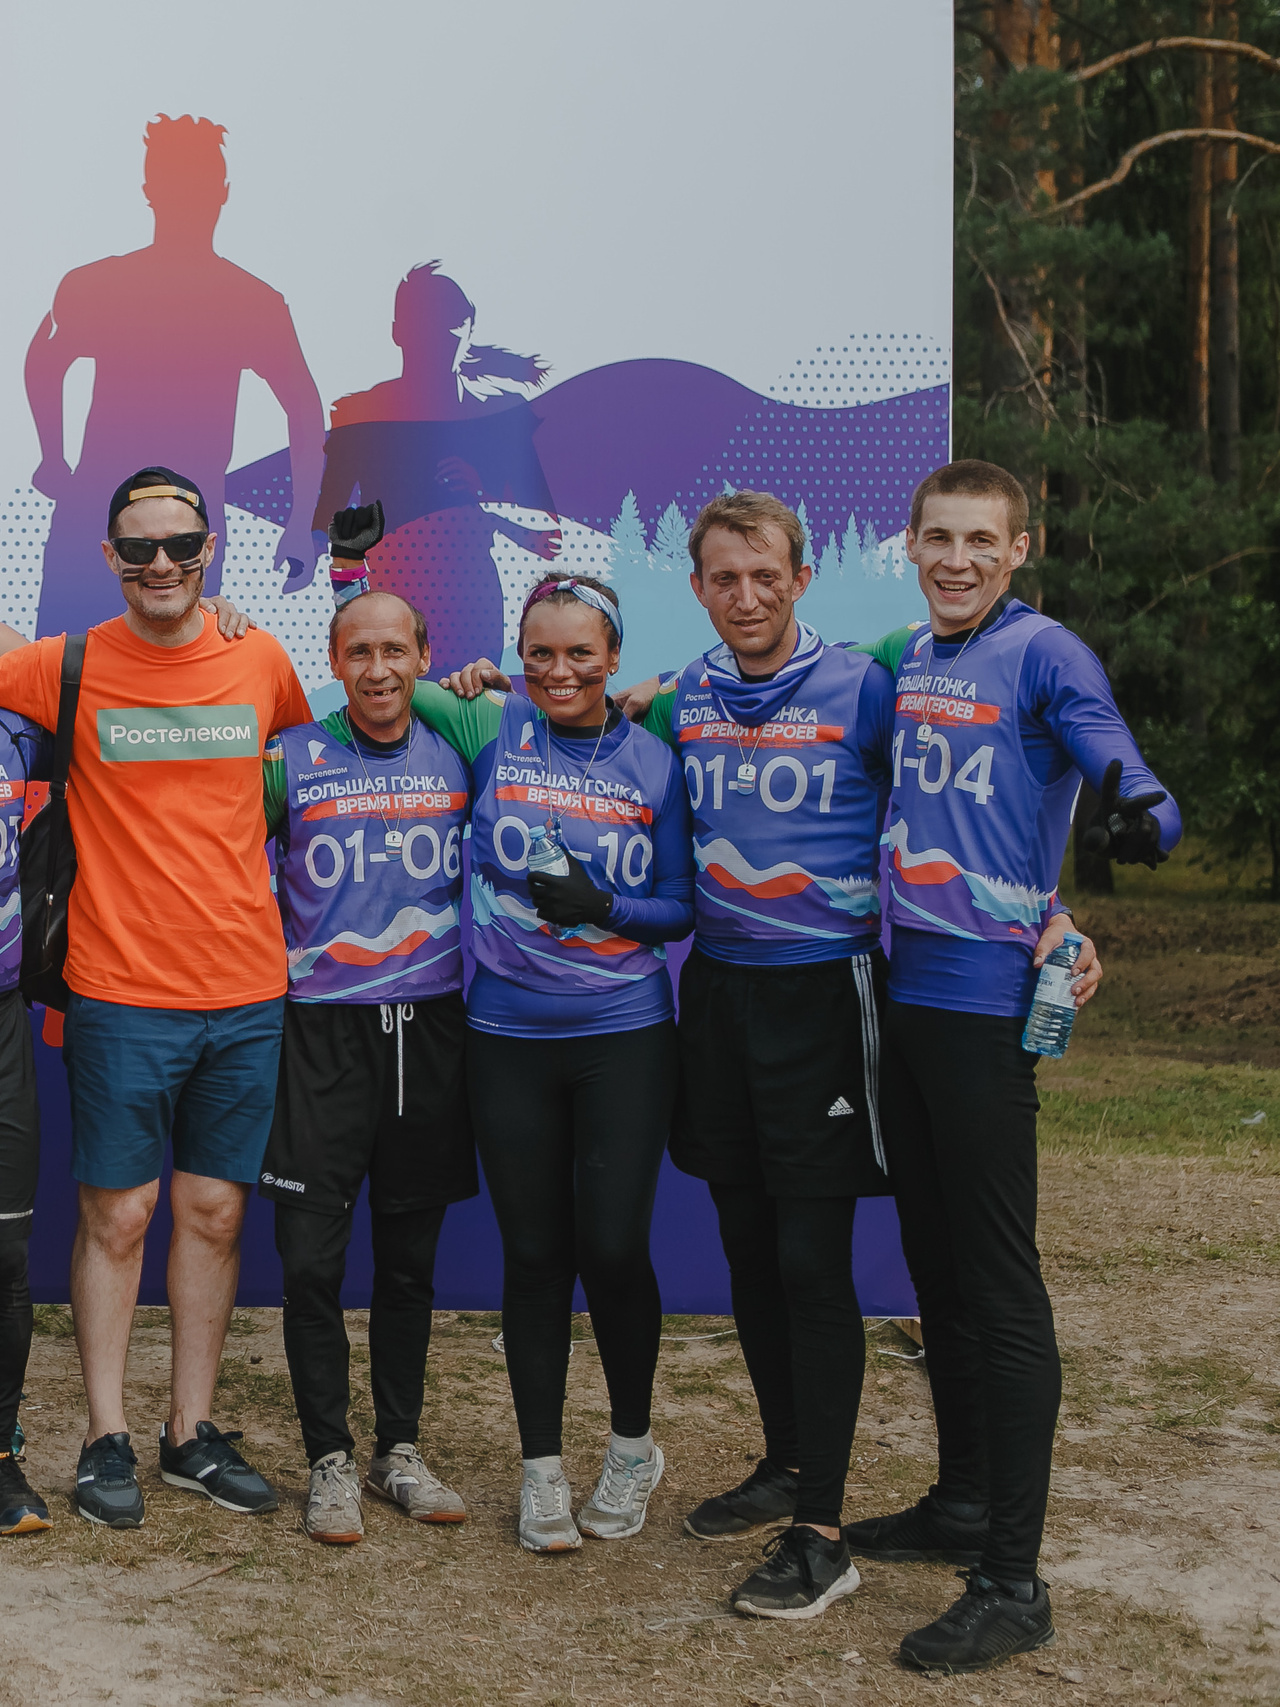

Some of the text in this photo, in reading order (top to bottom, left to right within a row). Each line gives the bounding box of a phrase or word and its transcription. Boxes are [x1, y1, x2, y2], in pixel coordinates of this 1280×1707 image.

[931, 676, 977, 700] ГОНКА
[679, 706, 721, 725] БОЛЬ
[899, 695, 975, 720] ВРЕМЯ ГЕРОЕВ
[110, 725, 251, 745] Ростелеком
[701, 722, 750, 738] ВРЕМЯ
[298, 766, 348, 782] Ростелеком
[892, 729, 995, 805] 1-04
[297, 775, 449, 804] БОЛЬШАЯ ГОНКА
[495, 764, 643, 806] БОЛЬШАЯ ГОНКА
[684, 754, 837, 813] 01-01
[336, 794, 452, 814] ВРЕМЯ ГЕРОЕВ
[527, 787, 642, 817] ВРЕМЯ ГЕРОЕВ
[304, 824, 460, 889] 01-06
[492, 815, 653, 887] 0-10
[828, 1107, 854, 1117] adidas
[275, 1177, 306, 1193] MASITA
